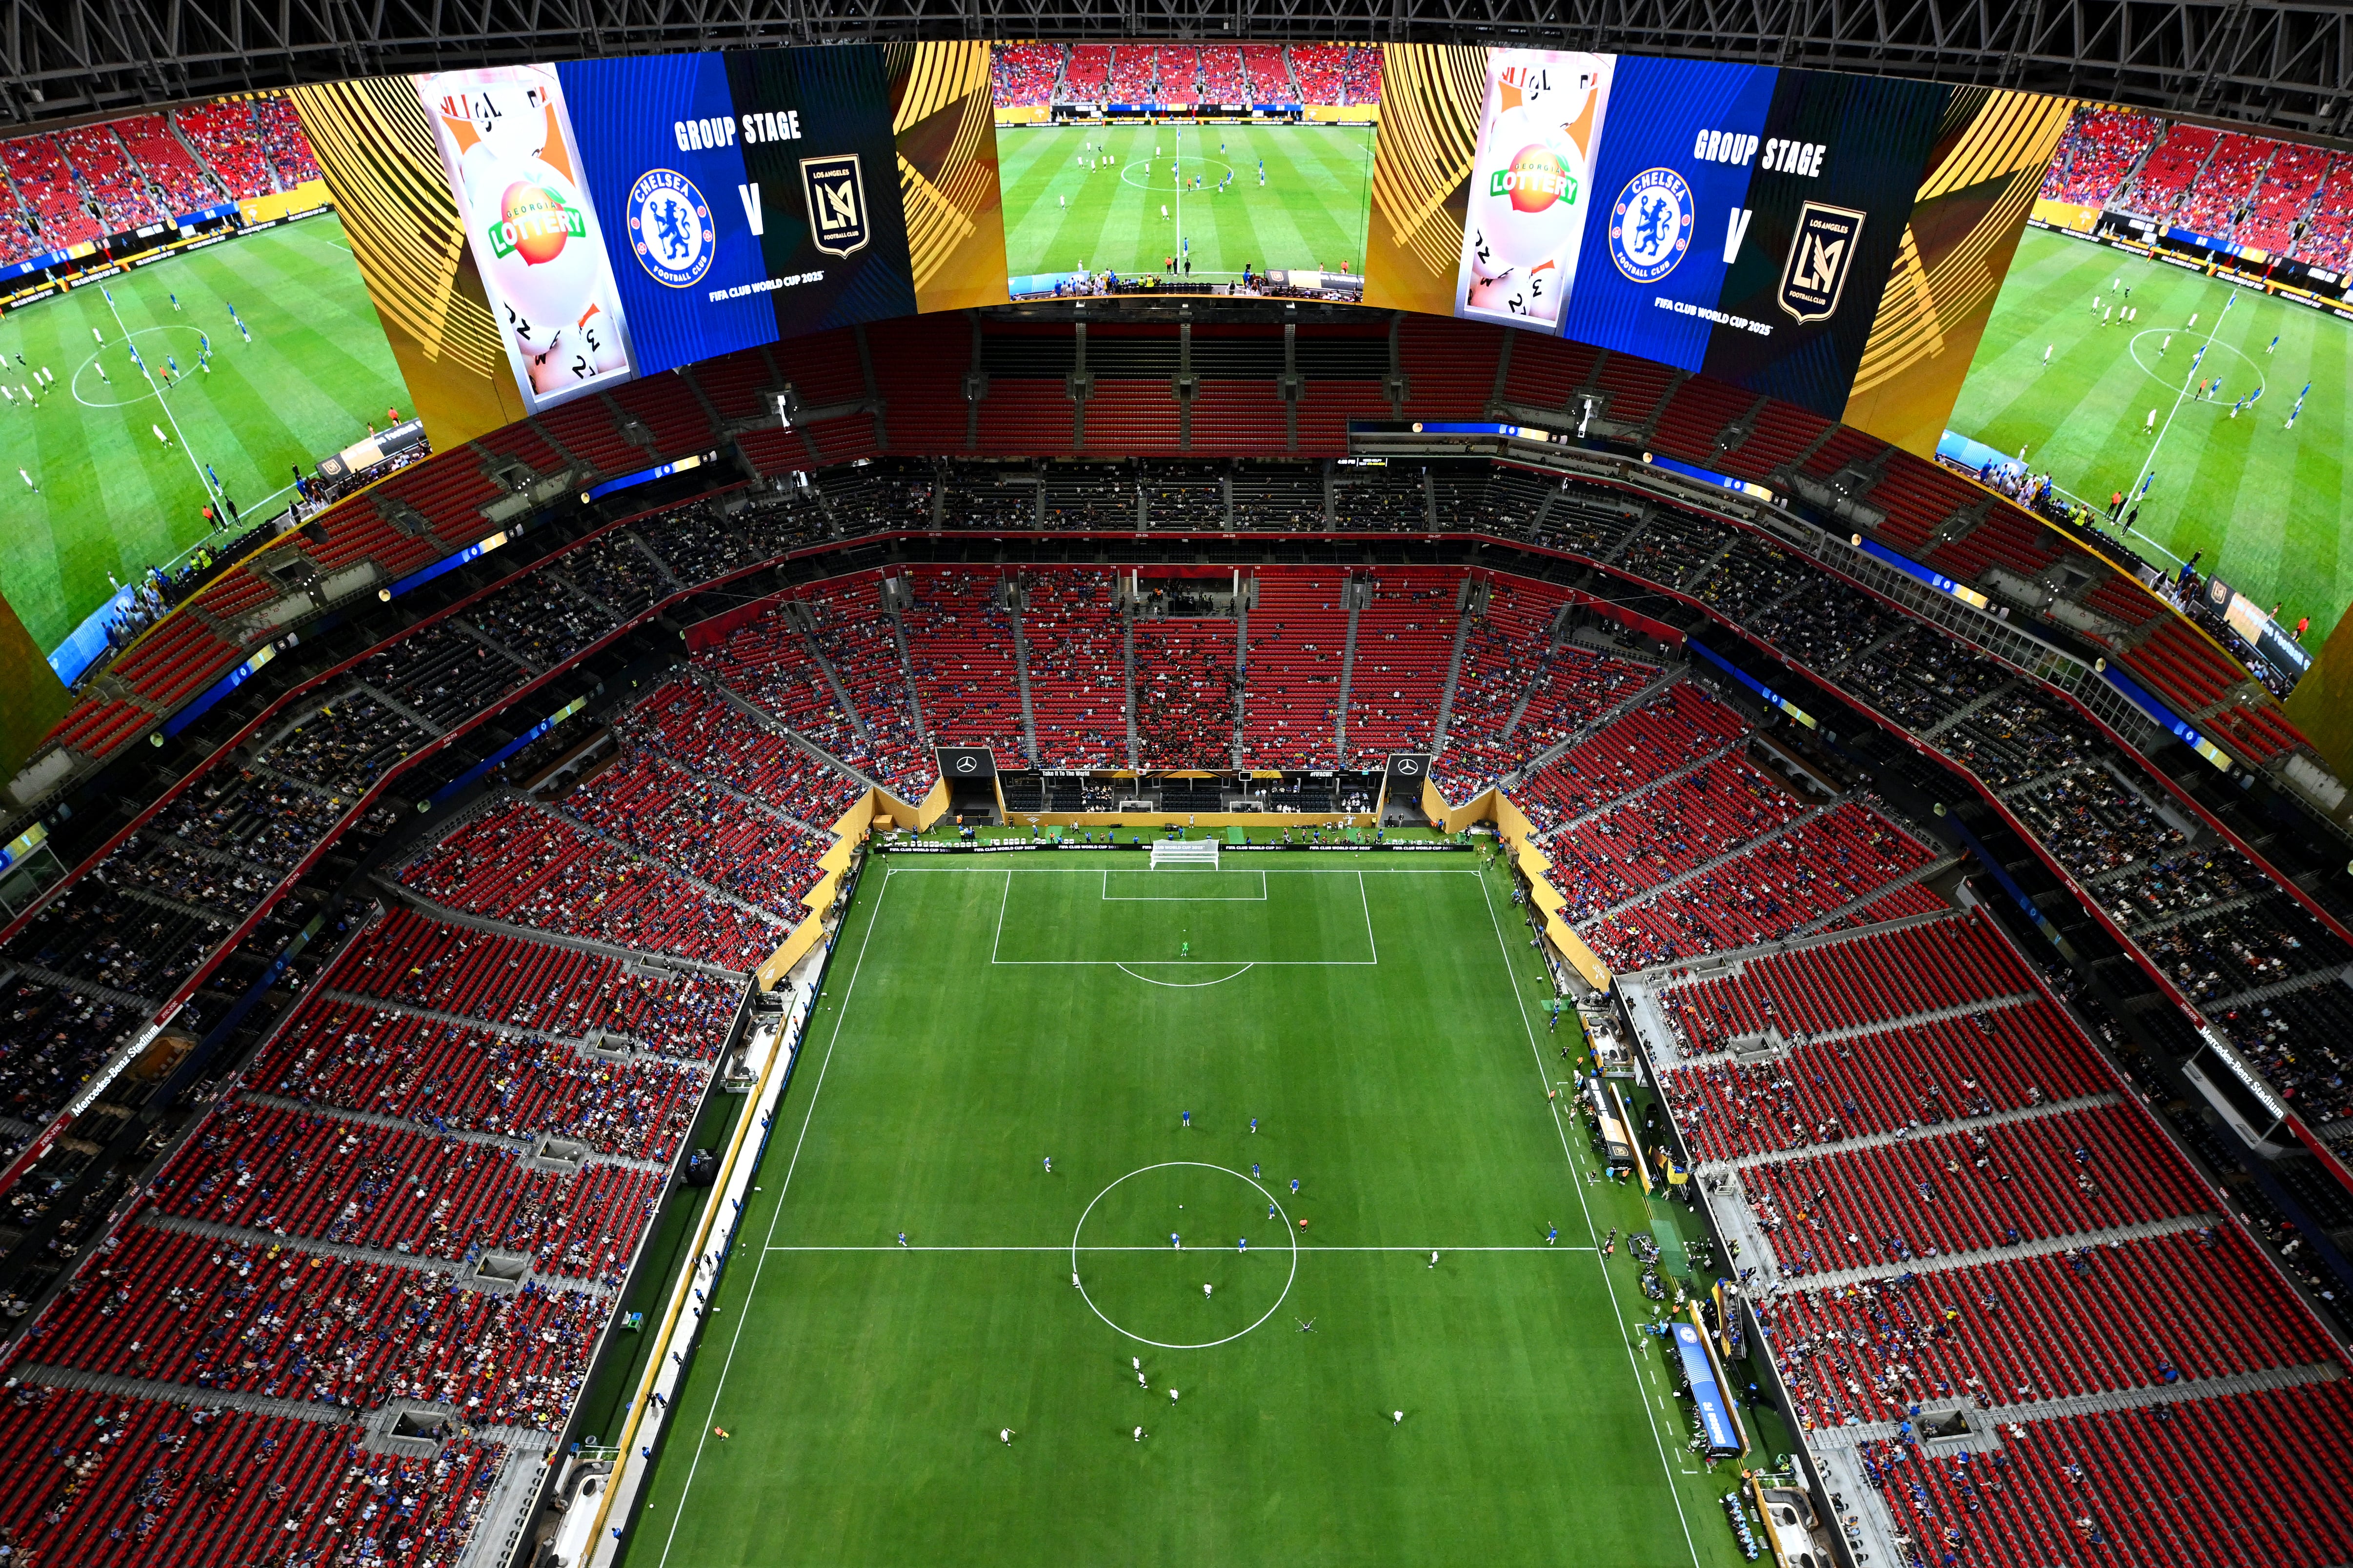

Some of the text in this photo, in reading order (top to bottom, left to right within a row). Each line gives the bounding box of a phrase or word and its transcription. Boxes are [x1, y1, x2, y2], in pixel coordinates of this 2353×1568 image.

[674, 110, 801, 151] GROUP STAGE
[1693, 129, 1826, 177] GROUP STAGE
[824, 169, 849, 178] ANGELES
[1515, 163, 1560, 174] GEORGIA
[634, 173, 689, 203] CHELSEA
[1491, 170, 1577, 200] LOTTERY
[1632, 172, 1686, 201] CHELSEA
[506, 201, 557, 218] GEORGIA
[738, 183, 764, 236] V
[490, 211, 581, 253] LOTTERY
[1722, 207, 1752, 263] V
[1809, 219, 1848, 234] LOS ANGELES
[653, 255, 707, 281] FOOTBALL CLUB
[1616, 251, 1670, 278] FOOTBALL CLUB
[708, 290, 728, 302] FIFA
[728, 285, 751, 298] CLUB
[751, 279, 783, 294] WORLD
[783, 275, 800, 286] CUP
[1789, 290, 1812, 302] FOOTBALL
[1654, 297, 1673, 310] FIFA
[1673, 302, 1696, 316] CLUB
[1697, 307, 1729, 324] WORLD
[1729, 315, 1748, 328] CUP
[71, 1025, 160, 1117] Mercedes-Benz Stadium
[2199, 1025, 2284, 1119] Mercedes-Benz Stadium
[1702, 1401, 1714, 1411] FC
[1708, 1412, 1726, 1444] Chelsea
